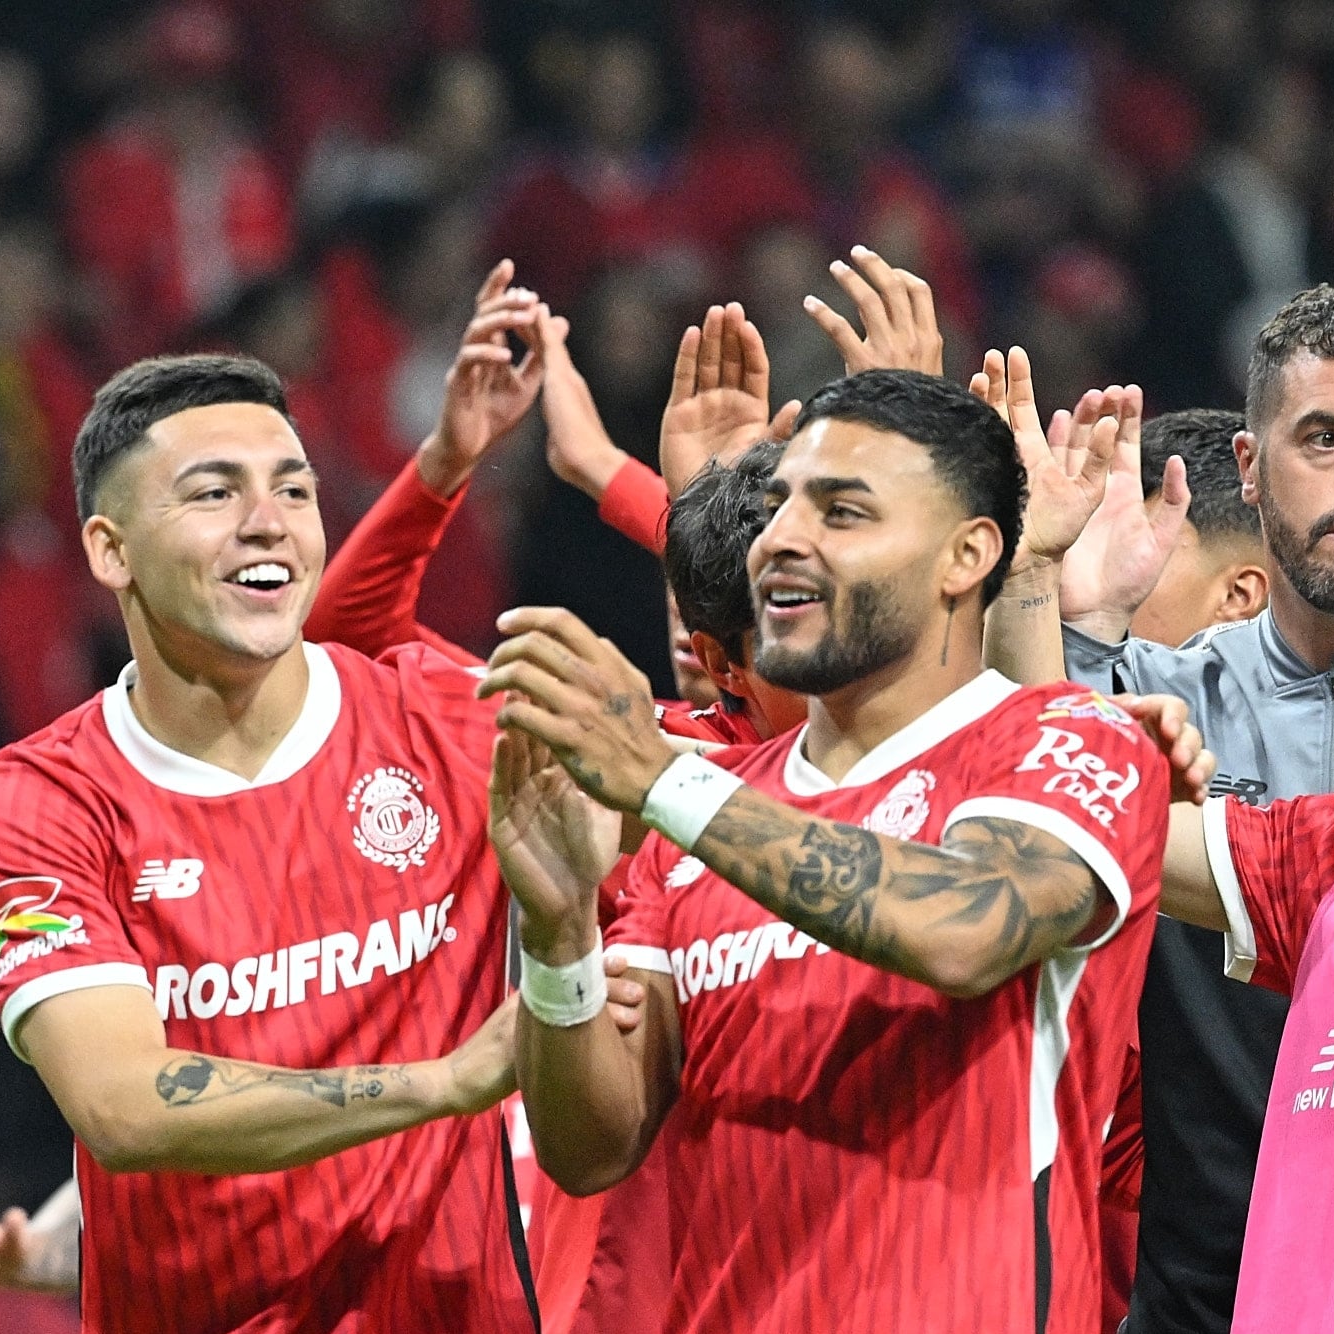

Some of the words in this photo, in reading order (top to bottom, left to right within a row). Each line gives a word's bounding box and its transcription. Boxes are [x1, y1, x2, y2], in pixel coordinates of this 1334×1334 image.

[1014, 725, 1140, 814] Red
[1043, 770, 1115, 829] Cola
[154, 893, 455, 1020] ROSHFRANS
[1292, 1086, 1329, 1114] new
